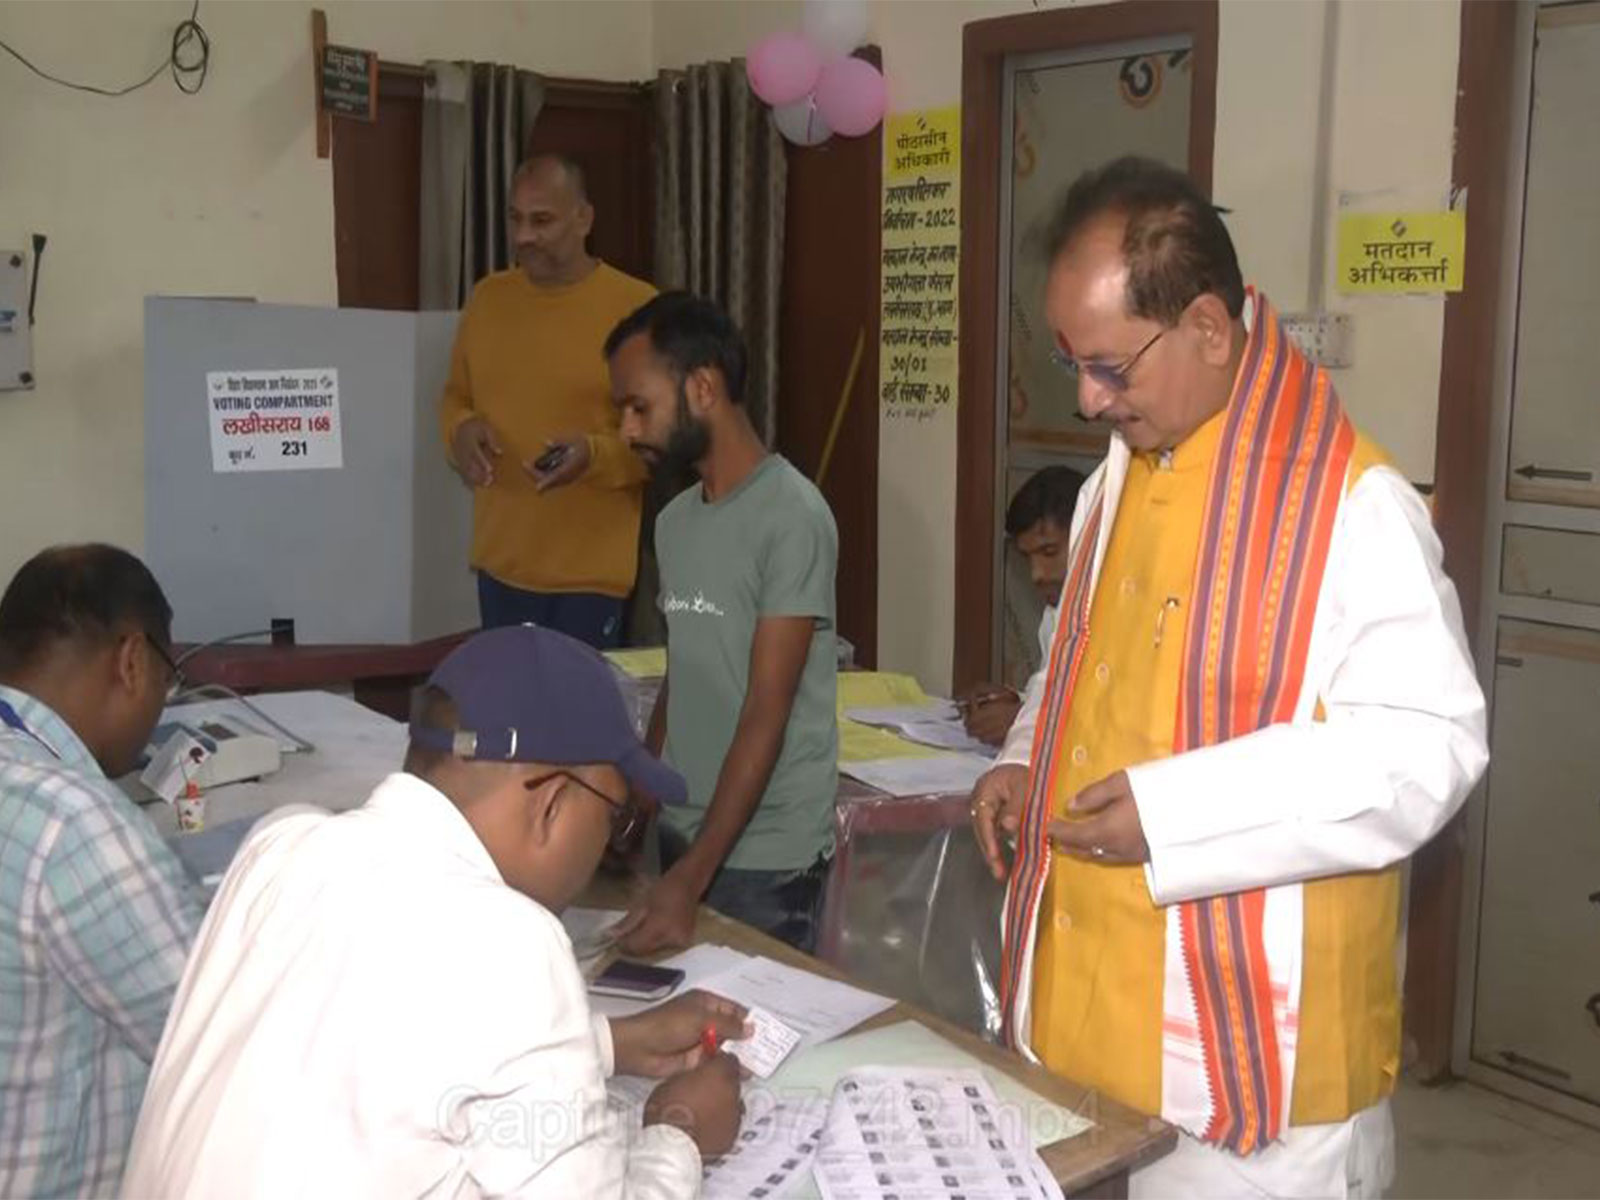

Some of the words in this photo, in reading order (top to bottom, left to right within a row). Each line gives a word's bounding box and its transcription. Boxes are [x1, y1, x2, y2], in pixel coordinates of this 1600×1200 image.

[896, 128, 947, 149] पीठासीन
[896, 147, 950, 170] अधिकारी
[925, 207, 956, 229] 2022
[1363, 241, 1433, 260] मतदान
[890, 352, 927, 377] 30/01
[213, 396, 252, 411] VOTING
[254, 395, 333, 410] COMPARTMENT
[933, 384, 950, 404] 30
[222, 411, 302, 435] लखीसराय
[307, 415, 331, 432] 168
[281, 440, 308, 456] 231
